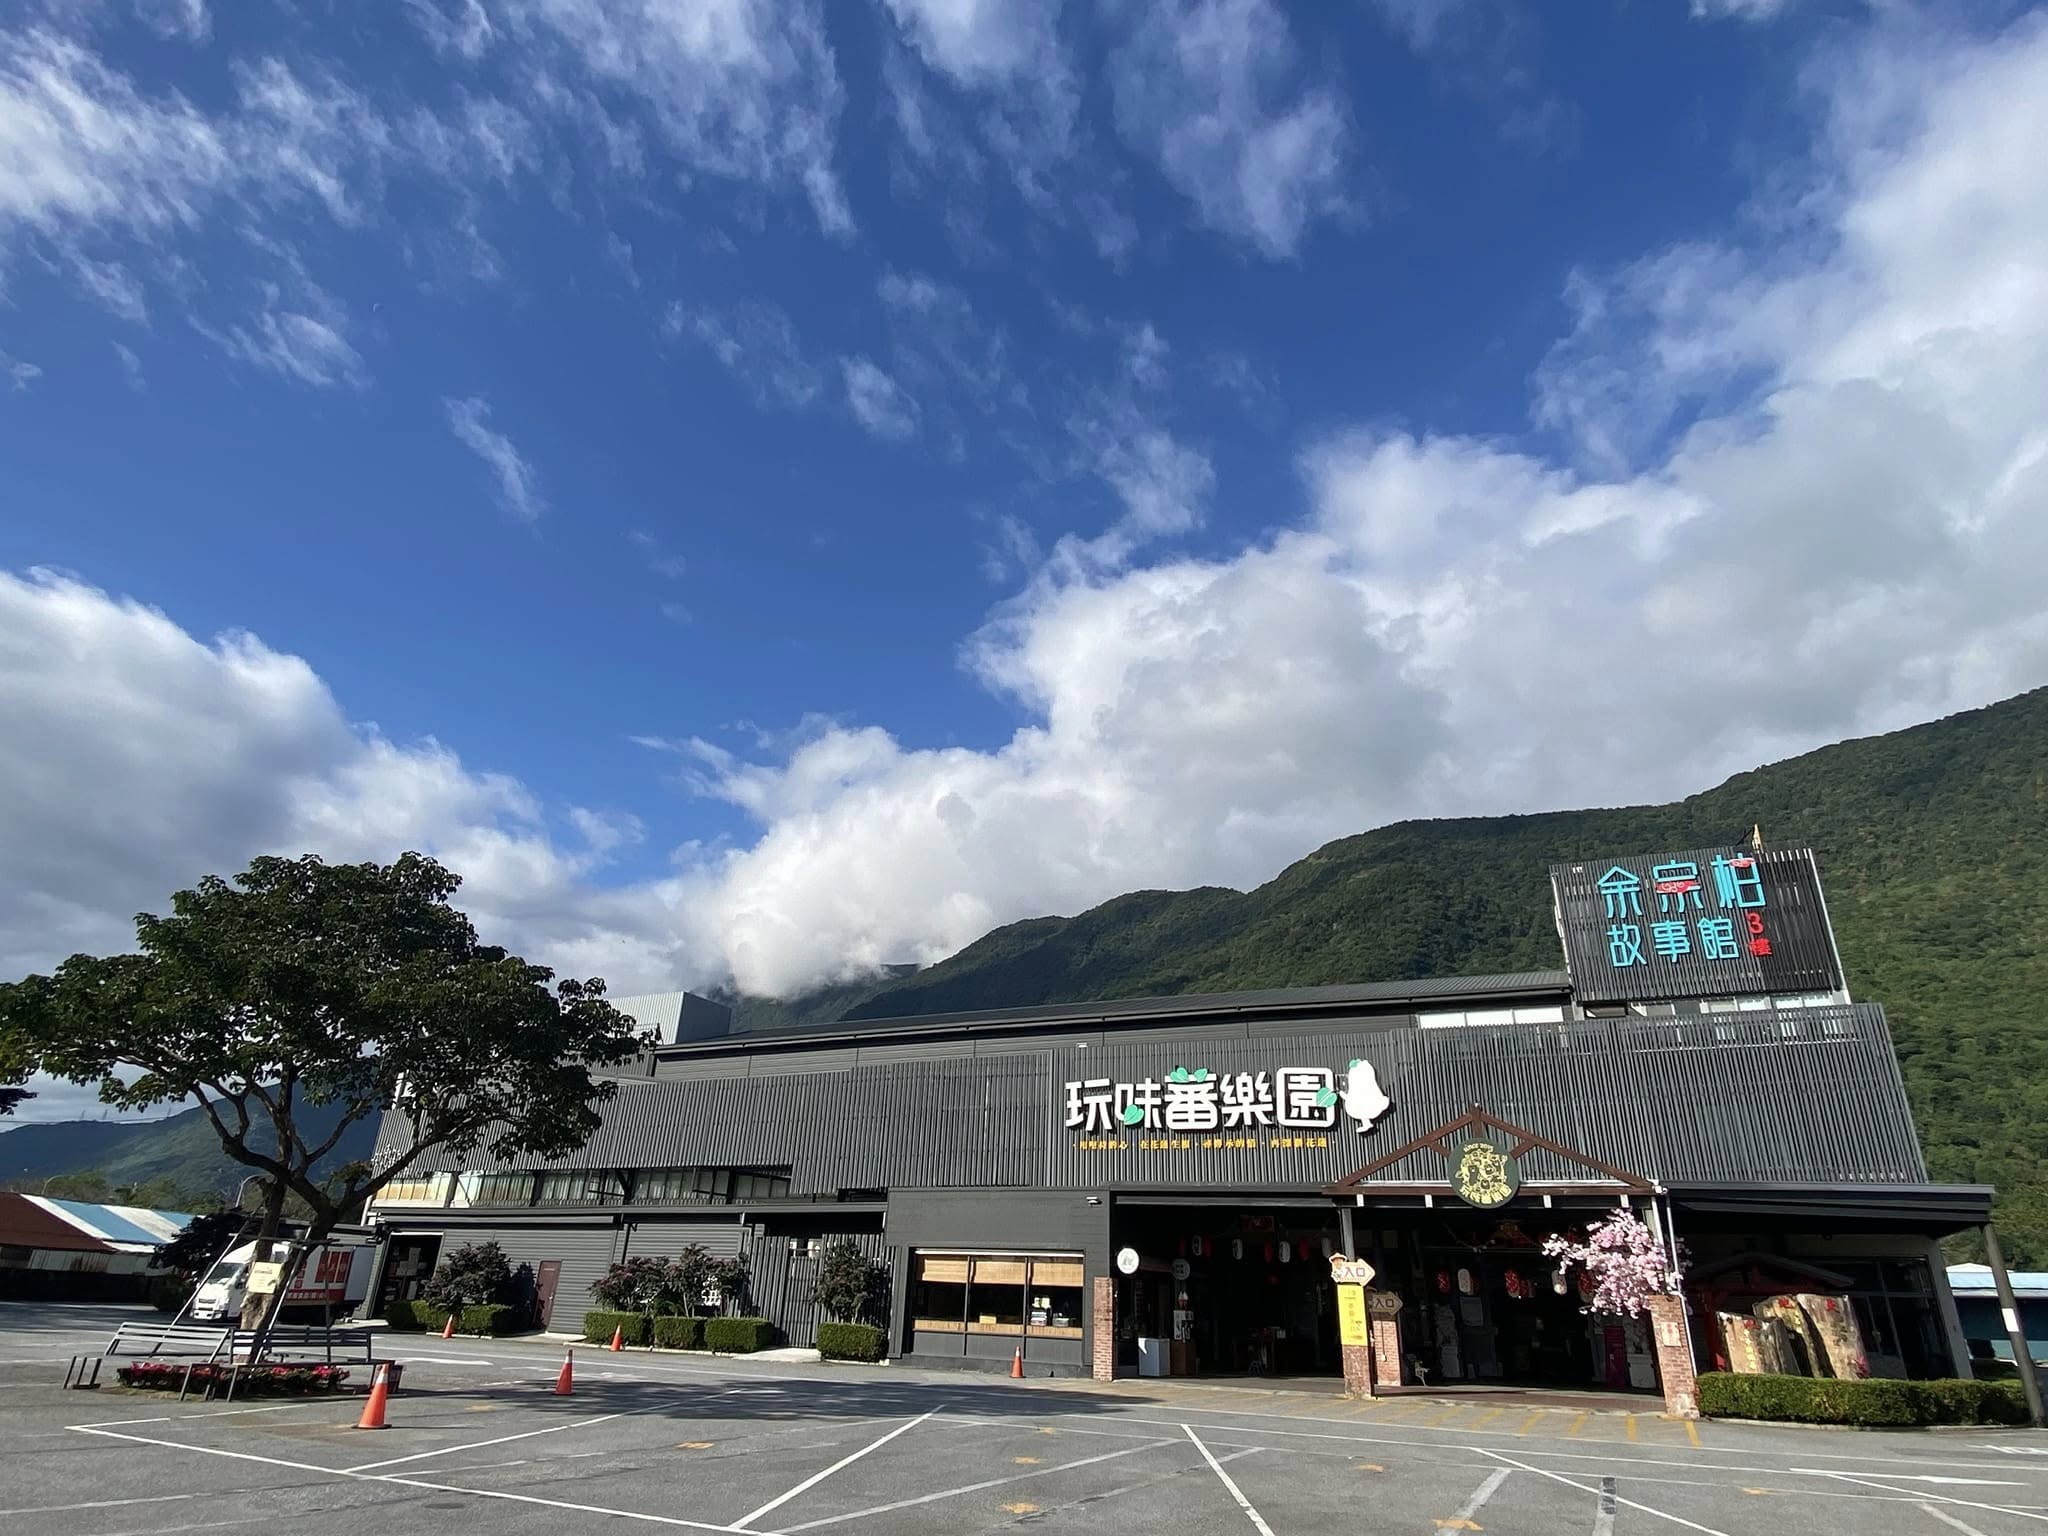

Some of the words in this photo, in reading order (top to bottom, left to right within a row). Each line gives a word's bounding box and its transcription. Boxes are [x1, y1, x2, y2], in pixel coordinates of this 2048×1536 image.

[1597, 853, 1766, 918] 余宗柏
[1606, 916, 1740, 967] 故事館
[1344, 1266, 1366, 1278] 入口
[1375, 1297, 1395, 1309] 入口
